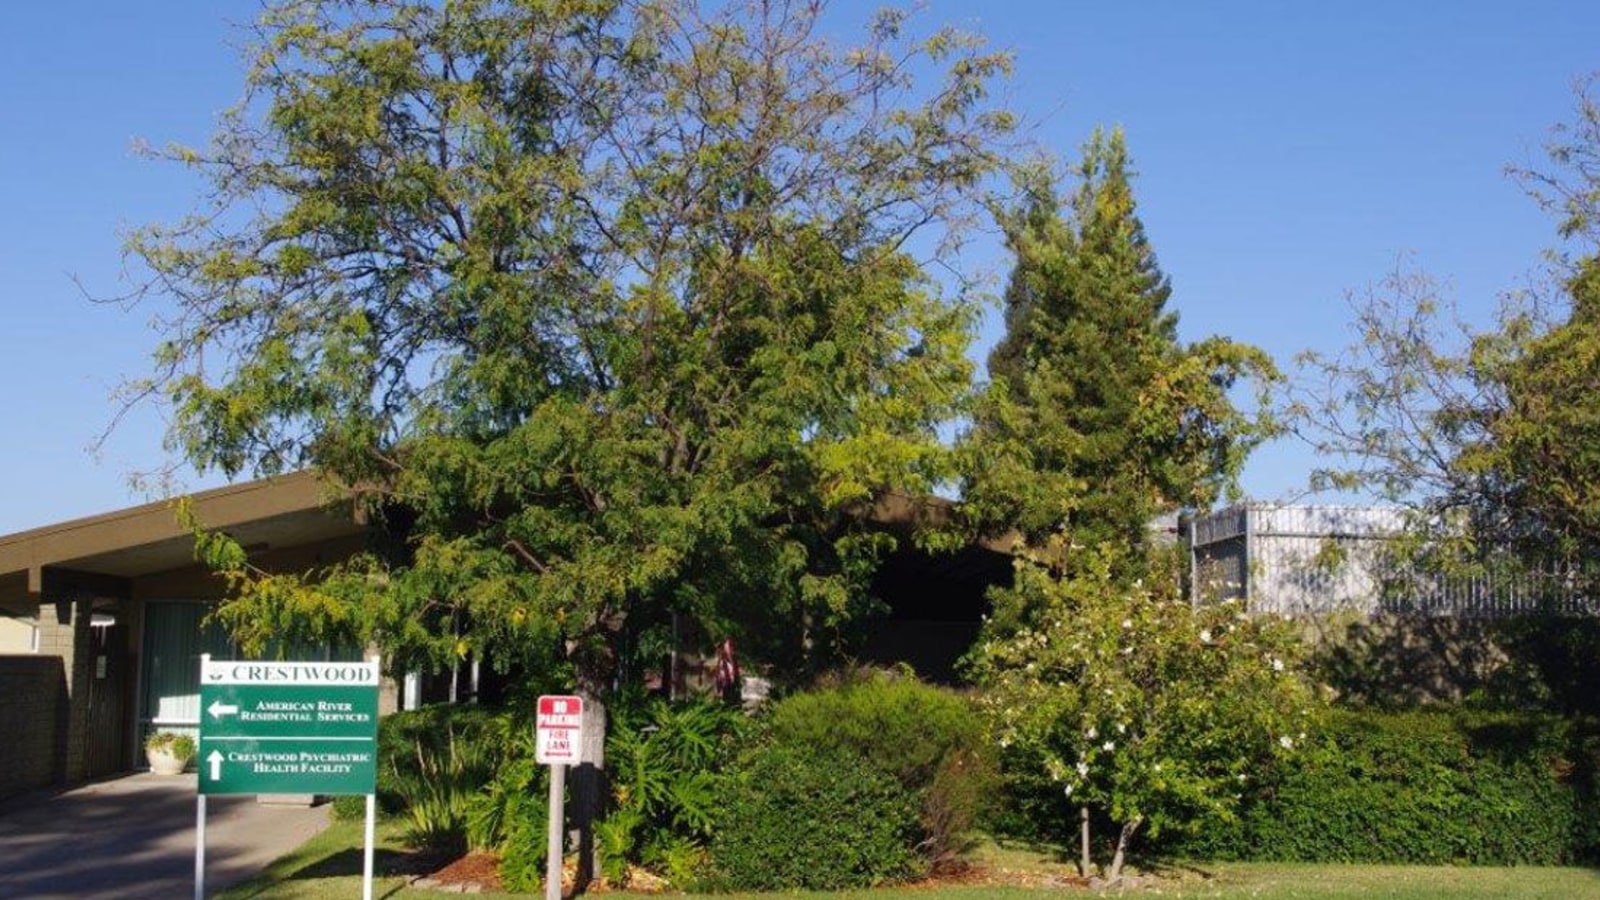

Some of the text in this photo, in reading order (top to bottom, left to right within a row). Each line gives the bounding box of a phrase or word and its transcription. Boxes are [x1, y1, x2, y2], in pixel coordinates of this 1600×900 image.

[232, 665, 372, 682] CRESTWOOD
[256, 701, 352, 711] AMERICAN RIVER
[553, 700, 568, 713] NO
[241, 711, 369, 722] RESIDENTIAL SERVICES
[549, 729, 569, 740] FIRE
[547, 740, 571, 750] LANE
[228, 752, 371, 762] CRESTWOOD PSYCHIATRIC
[254, 762, 352, 773] HEALTH FACILITY
